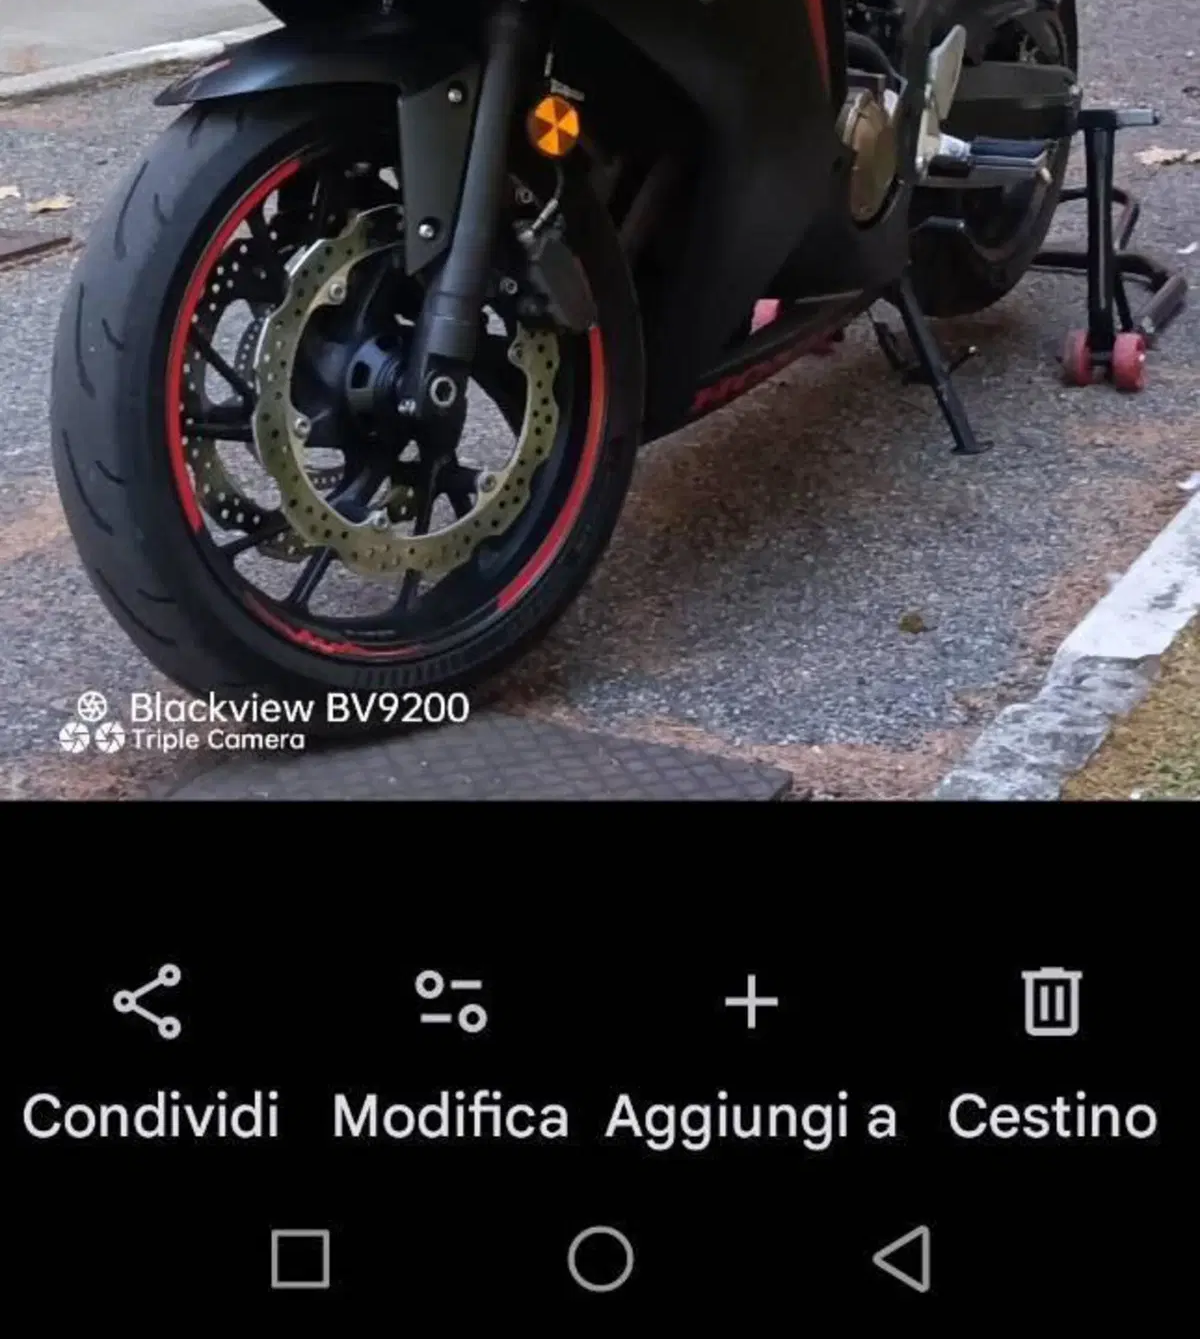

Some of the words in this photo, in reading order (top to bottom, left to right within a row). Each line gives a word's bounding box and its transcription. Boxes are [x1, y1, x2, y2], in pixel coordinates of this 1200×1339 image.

[22, 1090, 280, 1139] Condividi
[333, 1089, 568, 1139] Modifica
[604, 1090, 848, 1151] Aggiungi
[866, 1103, 897, 1139] a
[947, 1090, 1158, 1139] Cestino
